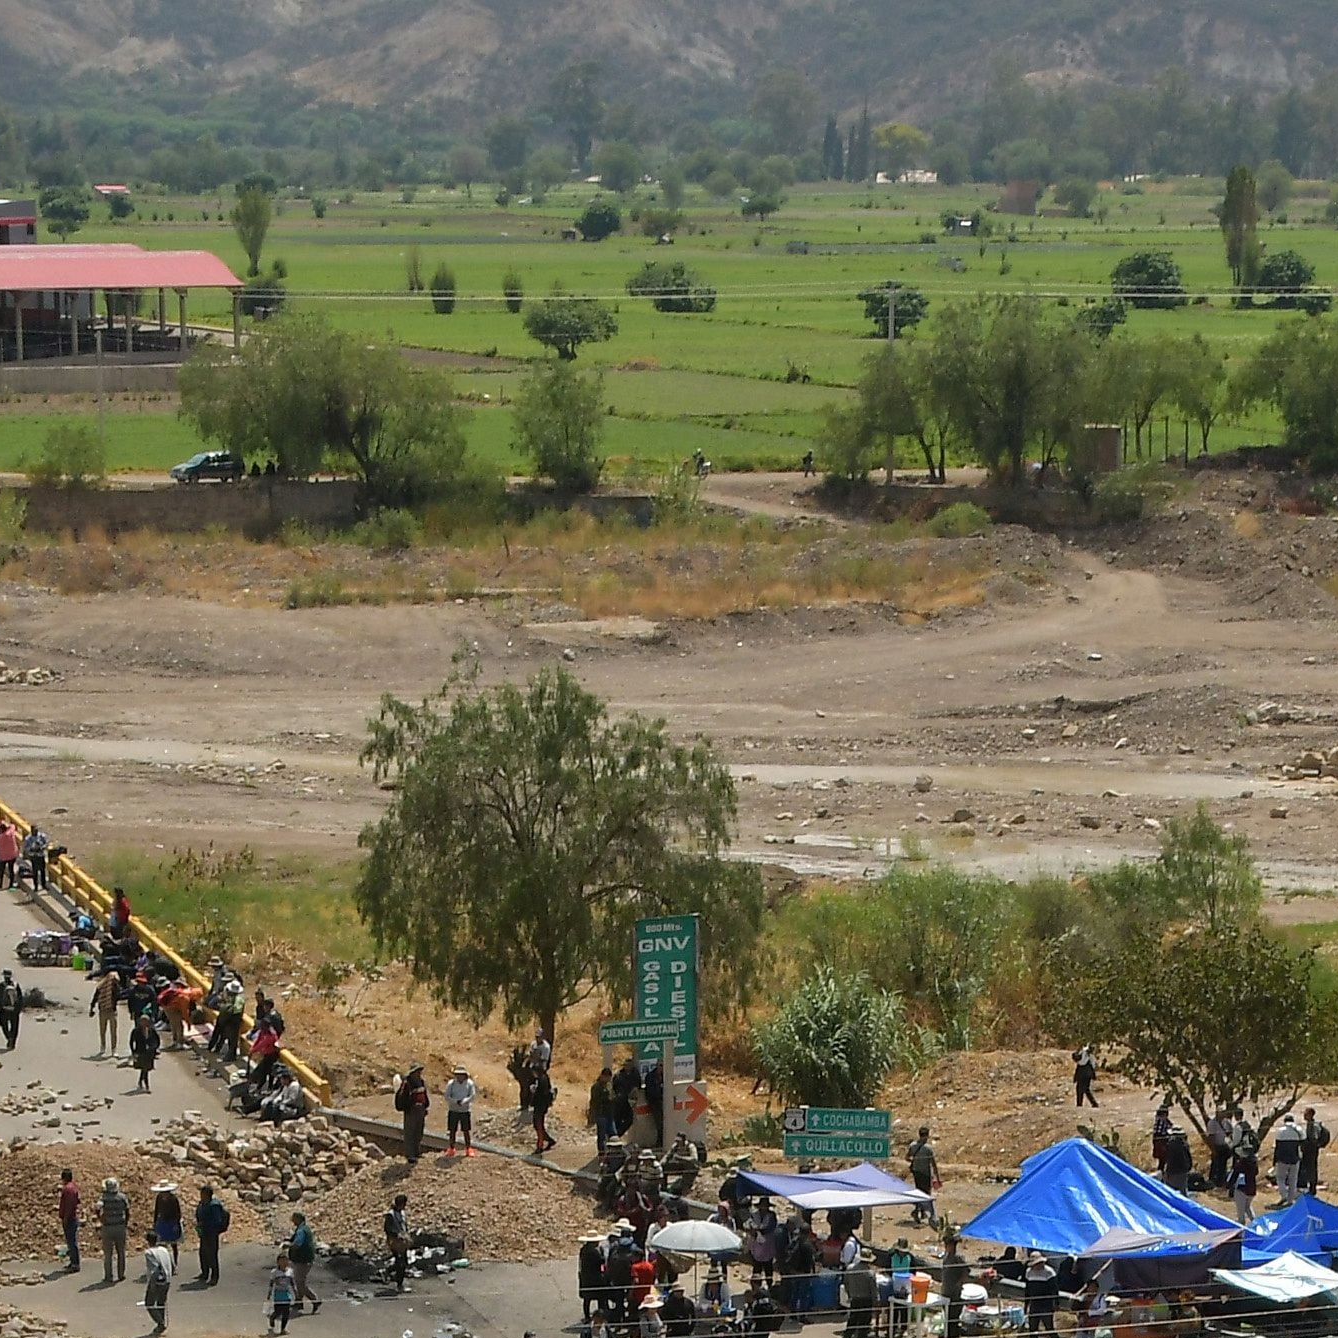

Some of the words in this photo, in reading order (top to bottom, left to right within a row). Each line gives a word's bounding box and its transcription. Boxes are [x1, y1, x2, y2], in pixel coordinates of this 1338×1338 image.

[638, 937, 690, 952] GNV
[642, 961, 660, 1052] GASOLA
[601, 1027, 634, 1038] PUENTE
[636, 1024, 678, 1036] PAROTANI
[790, 1118, 797, 1127] 4
[823, 1114, 886, 1128] COCHABAMBA
[805, 1139, 883, 1153] QUILLACOLLO
